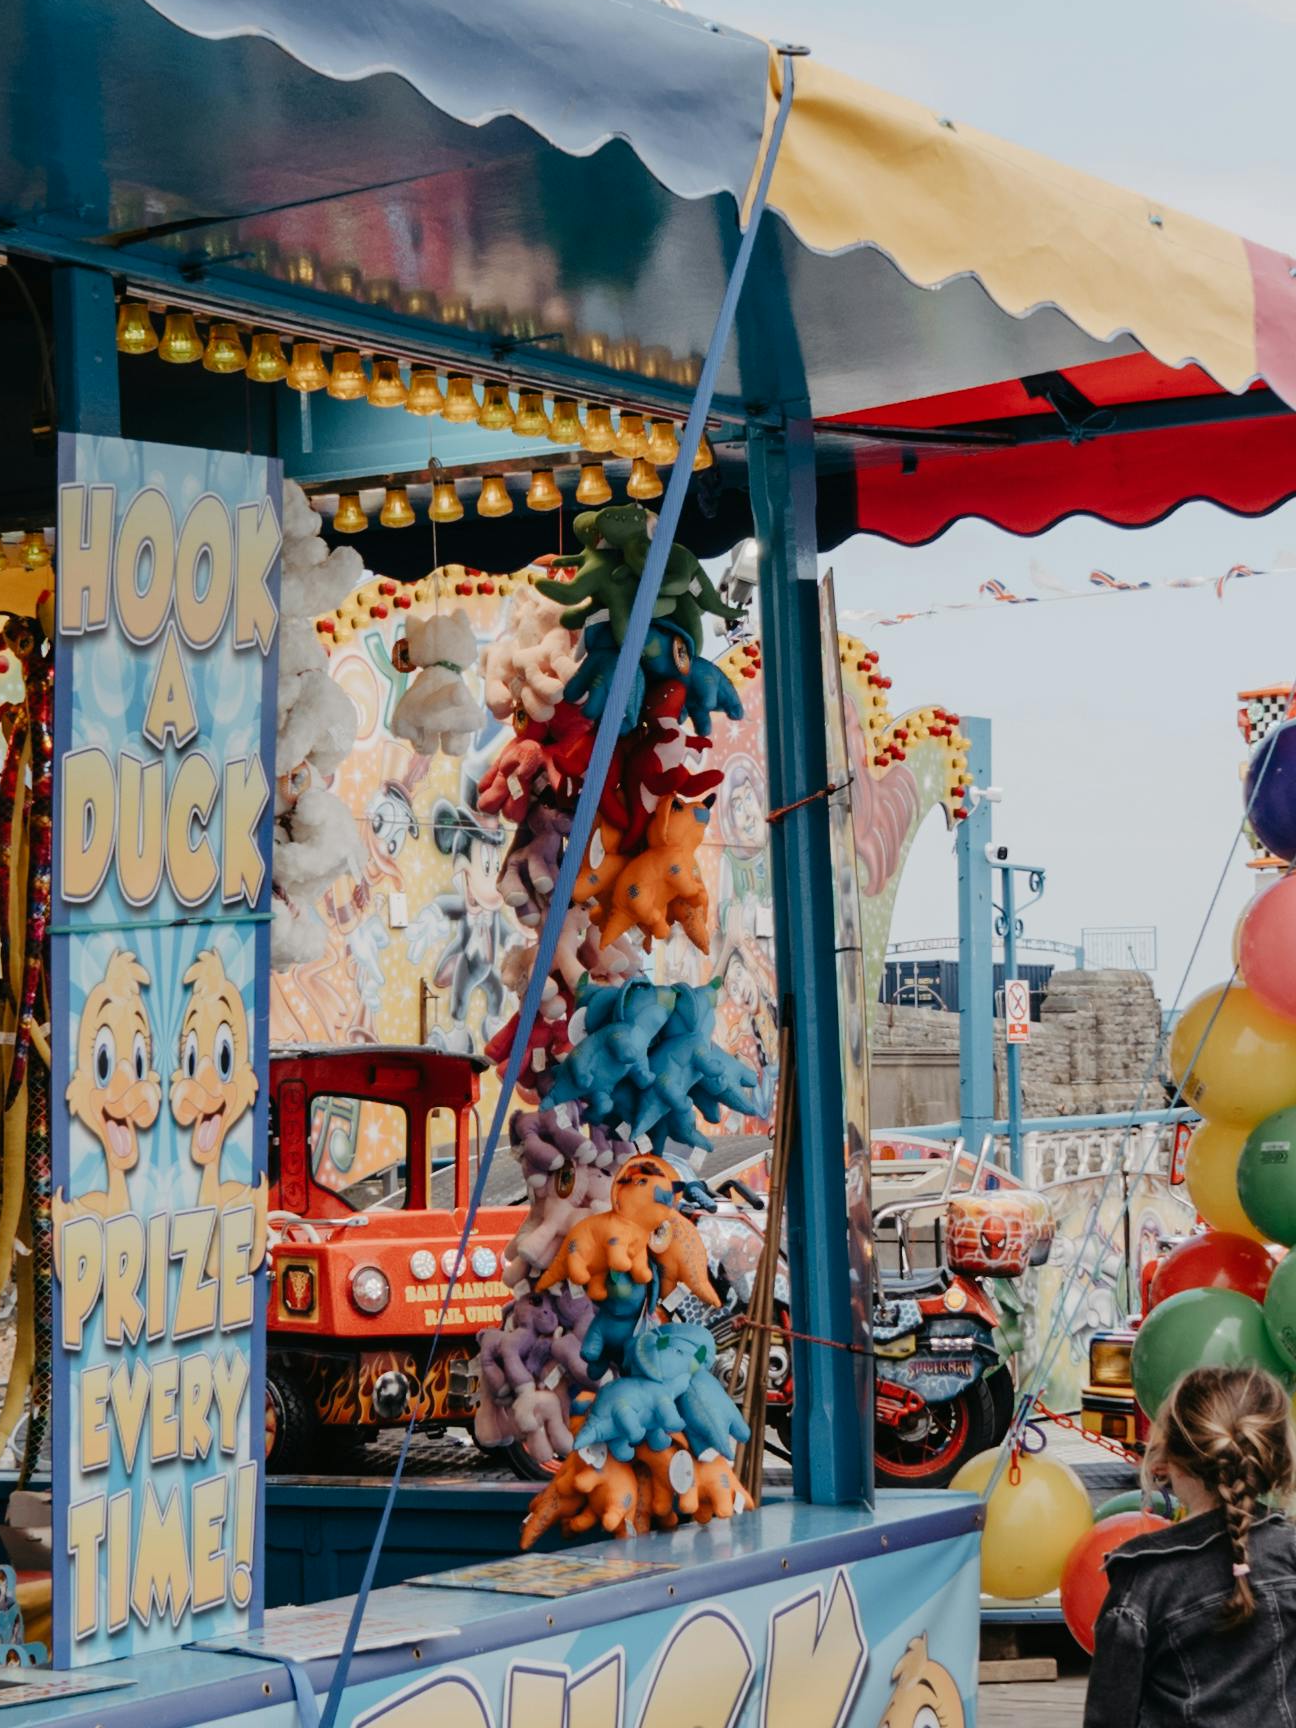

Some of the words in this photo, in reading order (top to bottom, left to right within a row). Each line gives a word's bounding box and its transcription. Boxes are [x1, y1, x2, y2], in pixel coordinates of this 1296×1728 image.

[57, 483, 282, 657] HOOK
[142, 621, 199, 750] A
[61, 745, 271, 909] DUCK
[61, 1205, 256, 1351] PRIZE
[405, 1284, 439, 1303] SAN
[439, 1280, 513, 1301] FRANCIS
[79, 1346, 250, 1473] EVERY
[67, 1460, 258, 1641] TIME!
